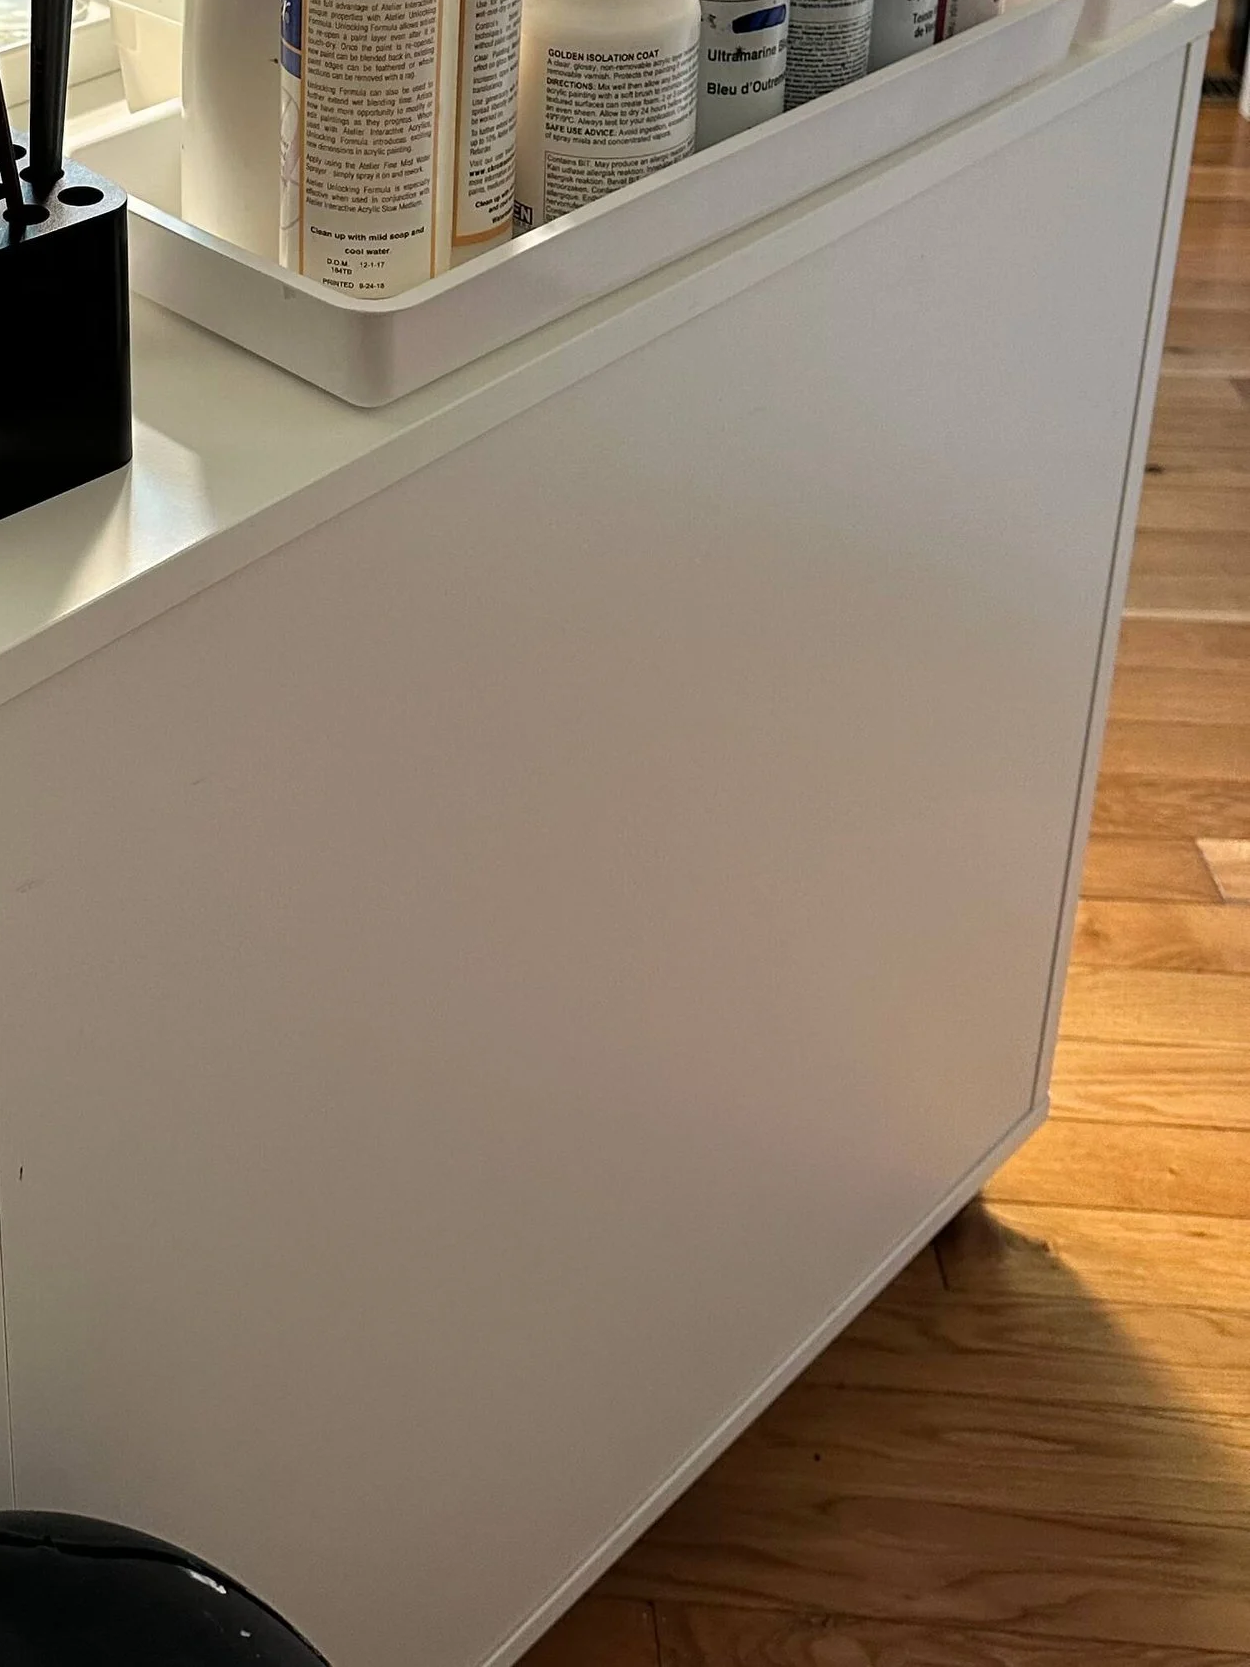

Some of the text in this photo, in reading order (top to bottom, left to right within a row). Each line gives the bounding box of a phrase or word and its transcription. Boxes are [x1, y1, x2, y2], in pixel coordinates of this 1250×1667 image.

[335, 21, 368, 32] Unlocking
[341, 43, 358, 51] Once
[549, 49, 659, 62] GOLDEN ISOLATION COAT
[708, 45, 776, 62] Ultramarine
[601, 62, 651, 70] non-removable
[354, 74, 383, 82] removed
[385, 73, 398, 81] with
[547, 68, 582, 79] removable
[547, 77, 595, 90] DIRECTIONS:
[707, 82, 736, 95] Bleu
[546, 88, 567, 97] acrylic
[569, 90, 596, 99] painting
[635, 89, 652, 98] brush
[546, 96, 573, 106] textured
[575, 99, 604, 108] surfaces
[621, 100, 642, 108] create
[357, 107, 394, 117] opportunity
[629, 109, 639, 118] dry
[641, 107, 649, 115] 24
[578, 116, 602, 126] Always
[630, 116, 644, 126] your
[545, 123, 564, 133] SAFE
[619, 127, 638, 136] Avoid
[553, 135, 571, 143] spray
[573, 137, 591, 145] mists
[608, 136, 651, 145] concentrated
[547, 155, 576, 166] Contains
[595, 160, 609, 168] May
[612, 159, 639, 168] produce
[356, 172, 374, 181] spray
[327, 183, 390, 194] Unlocking Formula
[475, 197, 493, 208] Clean
[357, 205, 380, 214] Acrylic
[382, 205, 397, 213] Slow
[514, 201, 531, 224] EN
[311, 226, 425, 241] Clean up with mild soap and
[323, 278, 354, 288] PRINTED
